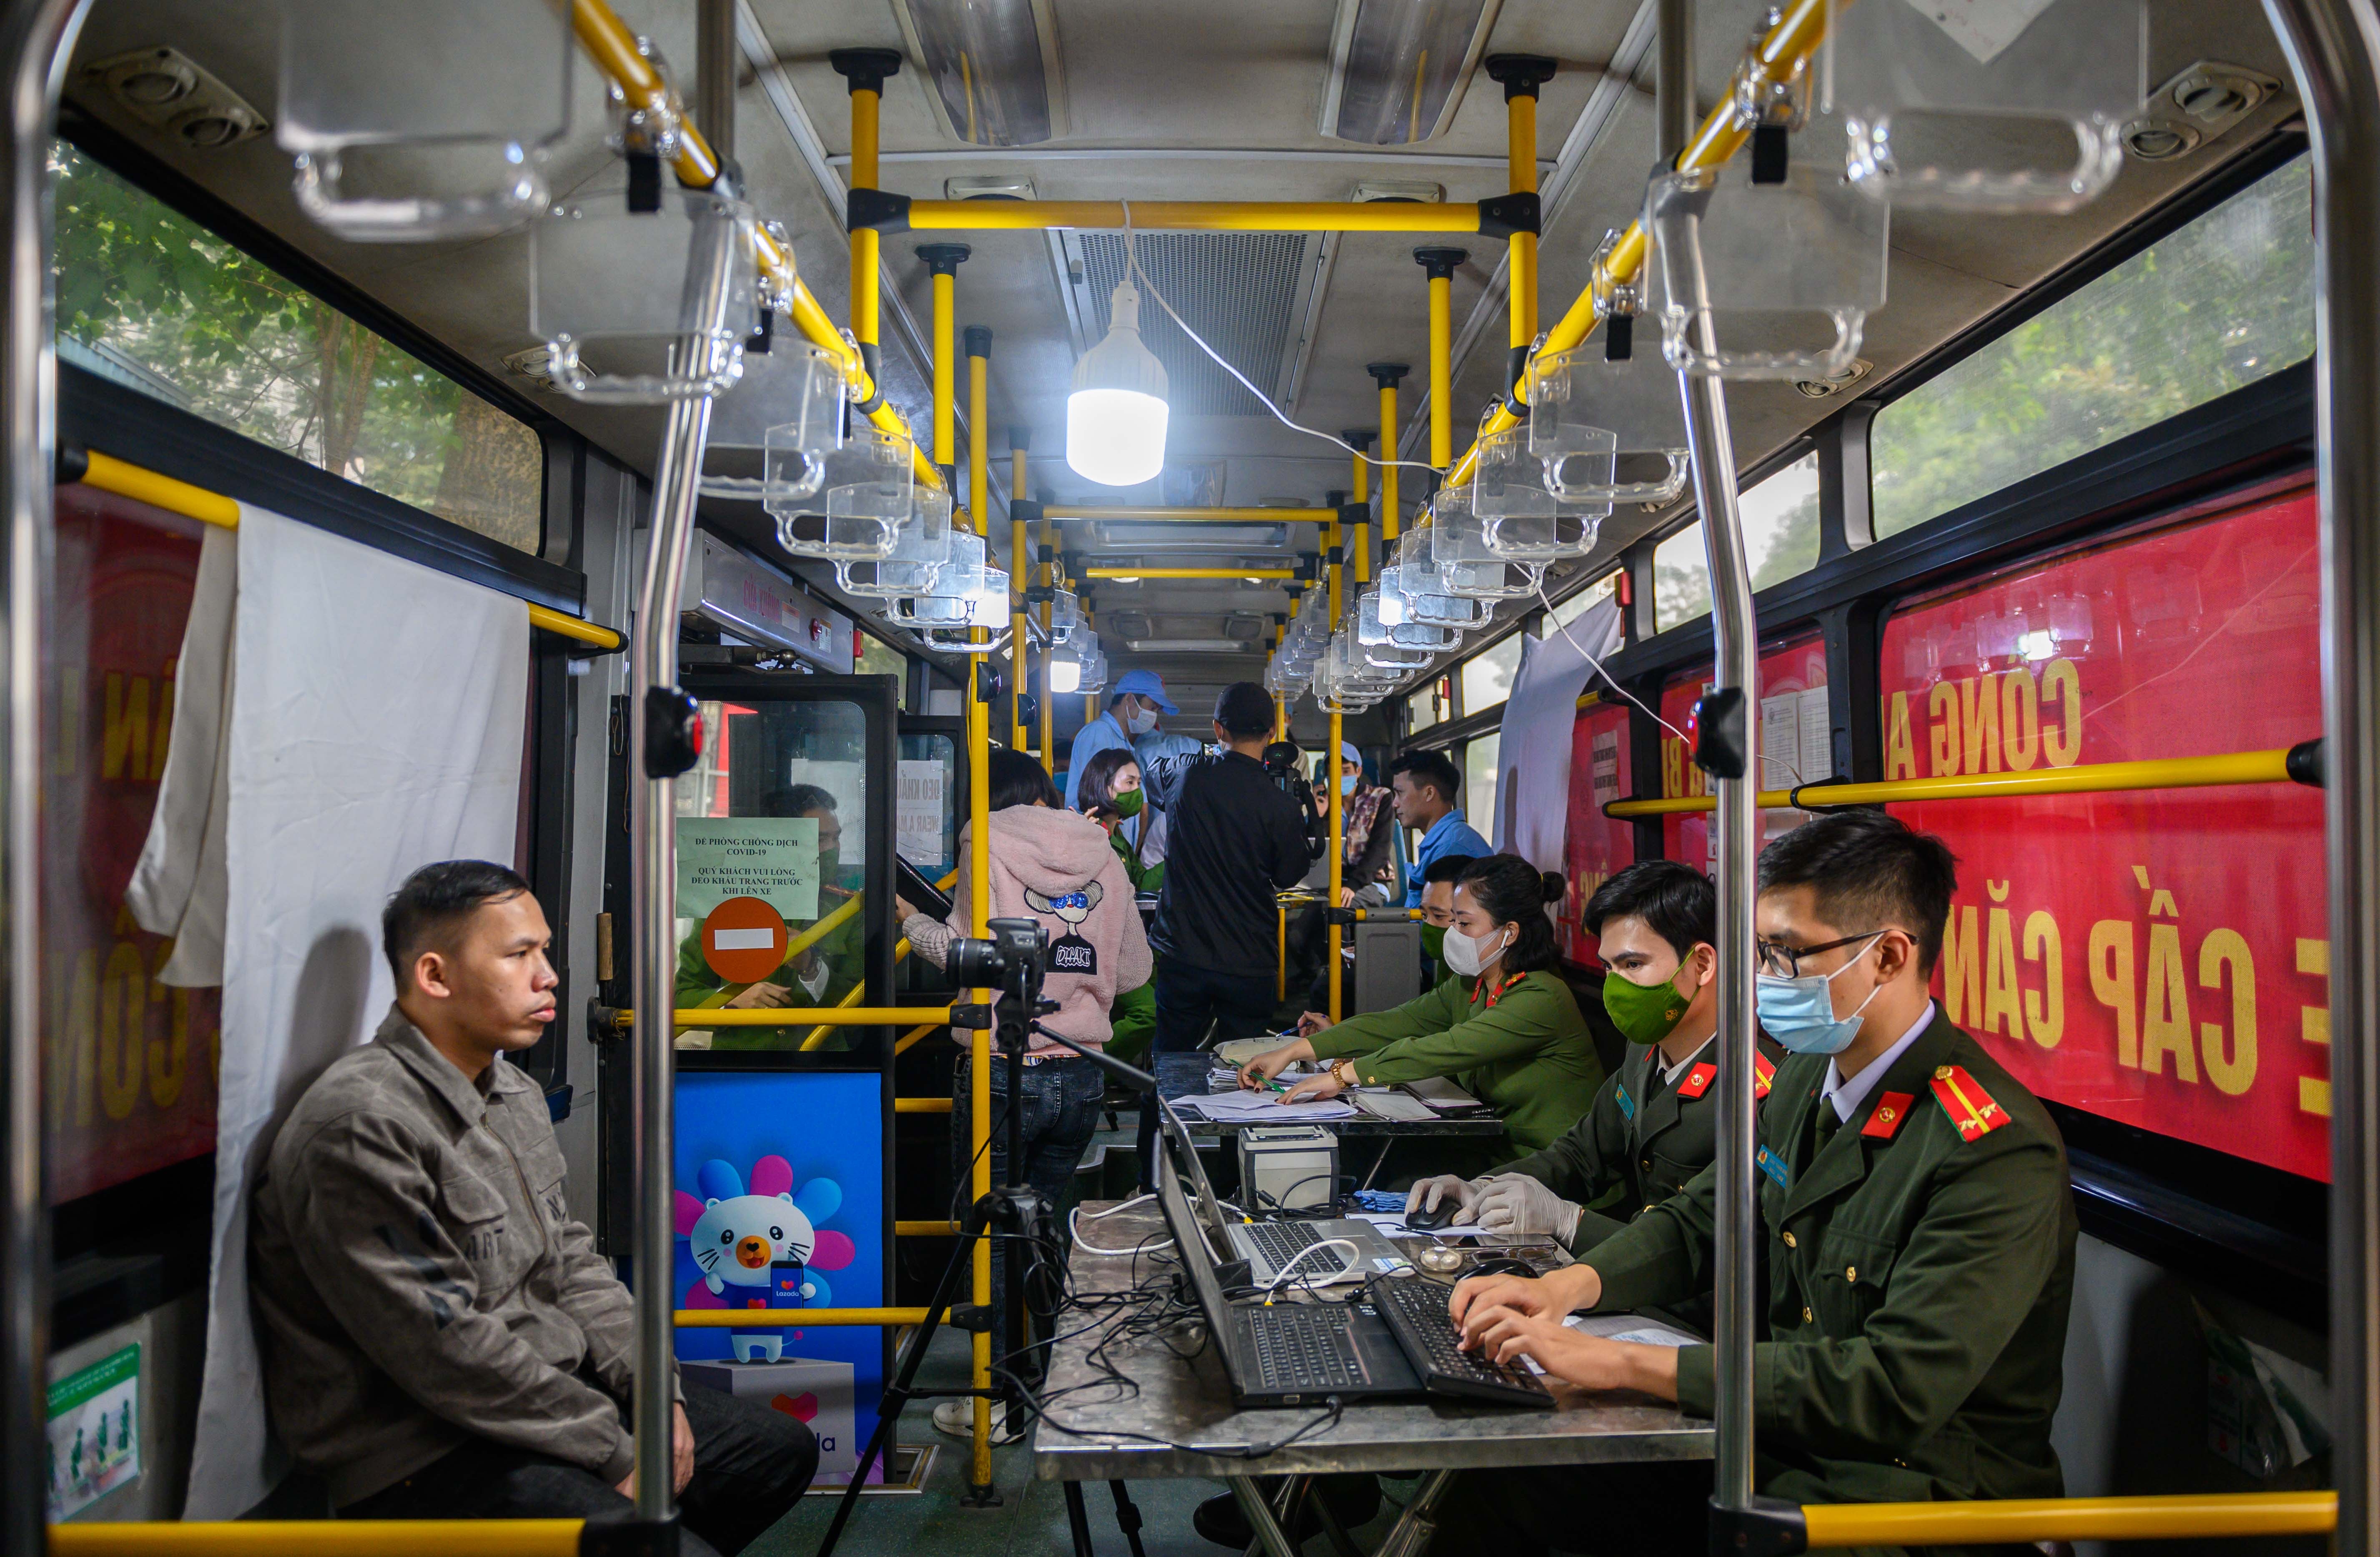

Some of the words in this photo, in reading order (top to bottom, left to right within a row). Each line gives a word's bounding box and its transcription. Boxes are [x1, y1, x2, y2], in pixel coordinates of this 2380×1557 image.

[710, 837, 739, 845] PHÒNG
[699, 866, 717, 875] QUÝ
[720, 866, 750, 875] KHÁCH
[771, 867, 795, 876] LÒNG
[772, 877, 803, 885] TRƯỚC
[741, 886, 757, 895] LÊN
